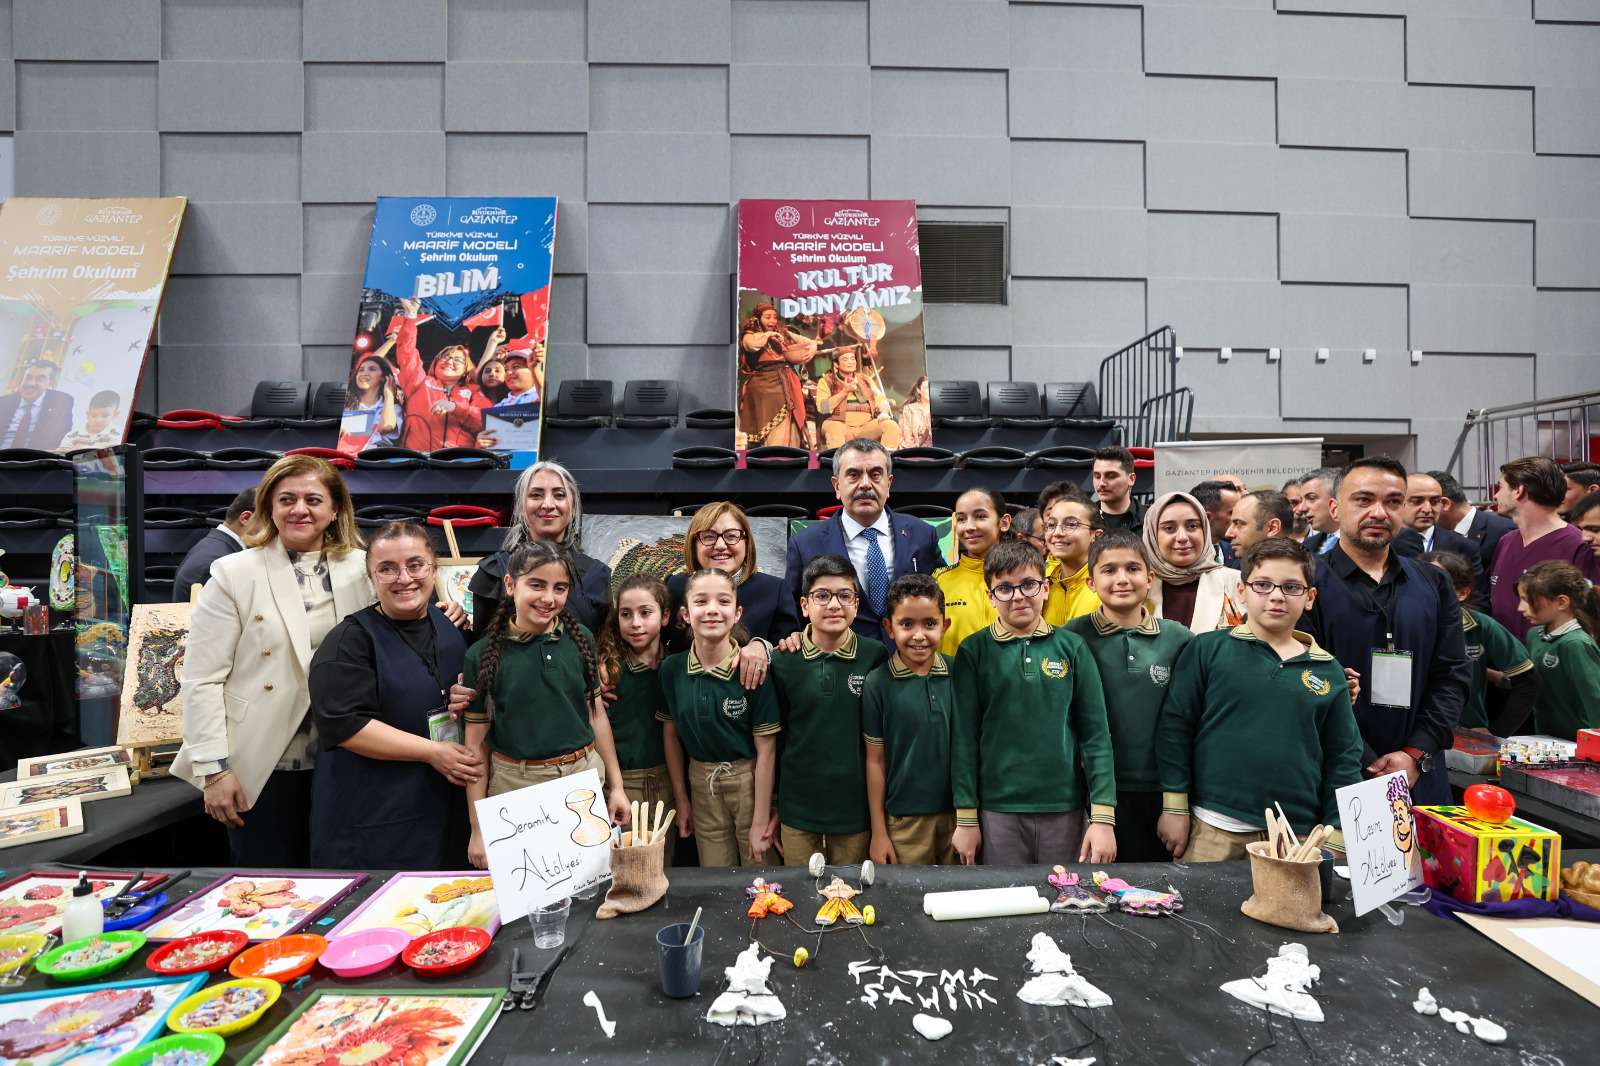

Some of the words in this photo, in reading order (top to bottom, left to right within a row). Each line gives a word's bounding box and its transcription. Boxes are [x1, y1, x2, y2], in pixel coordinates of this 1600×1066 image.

[403, 240, 459, 250] MAARİF
[772, 241, 826, 251] MAARİF
[420, 253, 456, 263] Şehrim
[459, 253, 498, 262] Okulum
[790, 254, 826, 264] Şehrim
[828, 254, 867, 263] Okulum
[8, 264, 68, 281] Şehrim
[73, 264, 137, 279] Okulum
[489, 805, 559, 847] Seramik
[848, 959, 998, 990] FATMA
